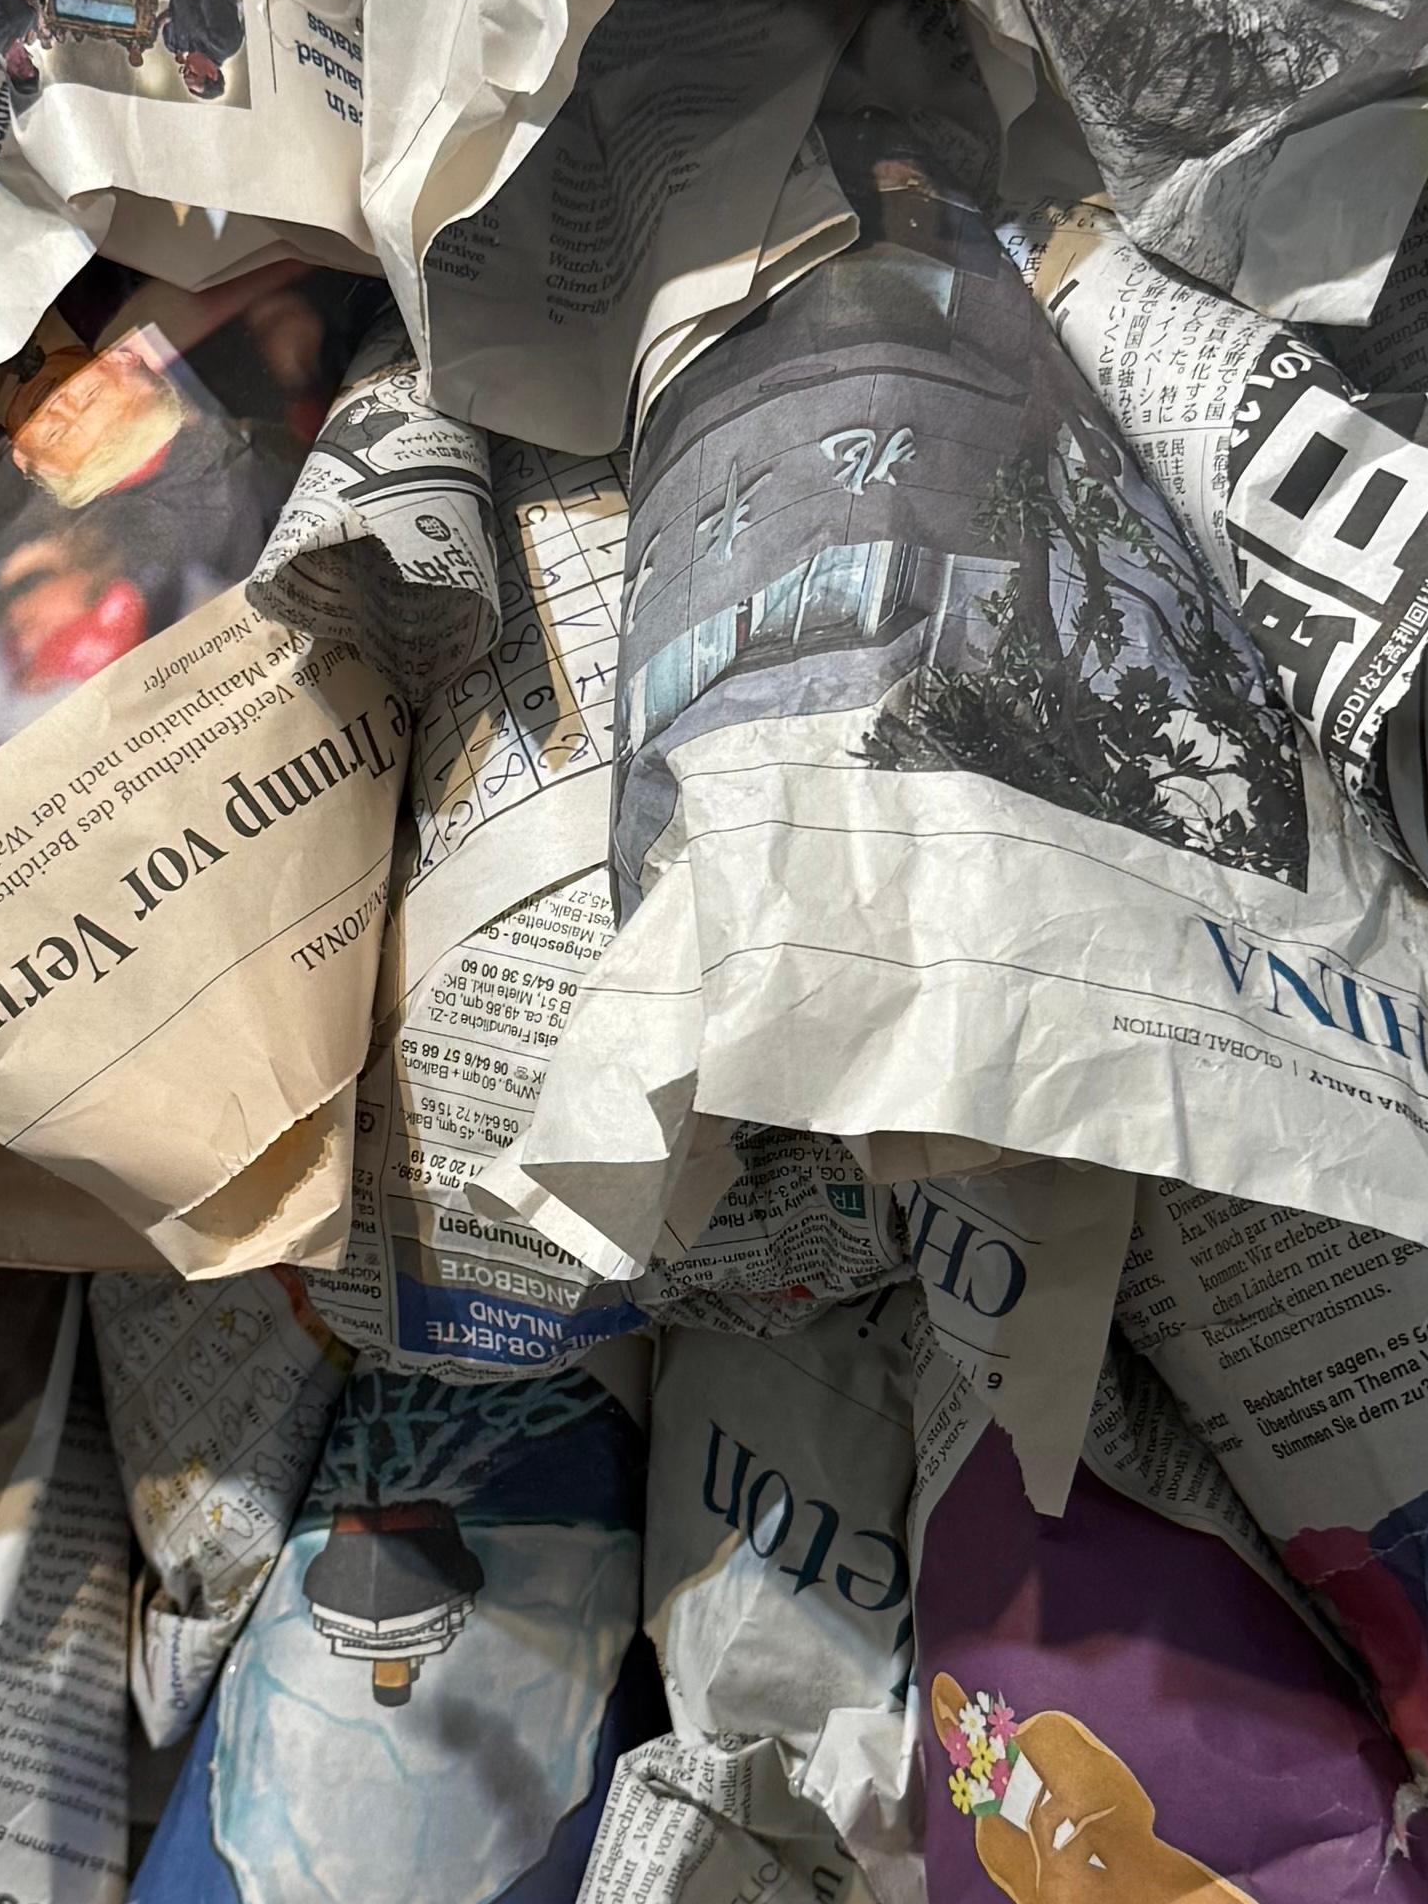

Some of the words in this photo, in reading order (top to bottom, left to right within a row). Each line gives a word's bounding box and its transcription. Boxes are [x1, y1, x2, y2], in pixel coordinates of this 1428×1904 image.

[143, 616, 253, 693] Niederndorfer
[123, 661, 268, 754] Manipulation
[66, 749, 125, 796] nach
[113, 684, 294, 803] Veröffentlichung
[224, 699, 398, 838] Trump
[30, 792, 68, 828] der
[75, 798, 116, 834] des
[120, 827, 228, 921] vor
[1111, 1014, 1203, 1046] EDITION
[407, 1148, 426, 1166] 19
[428, 1153, 449, 1171] 20
[447, 1158, 468, 1176] 20
[440, 1258, 582, 1310] ANGEBOTE
[468, 1300, 563, 1340] INLAND
[1248, 1282, 1393, 1355] Konservatismus.
[1241, 1369, 1325, 1416] Beobachter
[1325, 1346, 1387, 1380] sagen,
[1386, 1331, 1411, 1353] es
[1256, 1398, 1329, 1438] Überdruss
[1327, 1386, 1357, 1410] am
[1353, 1357, 1422, 1395] Thema
[1271, 1426, 1336, 1461] Stimmen
[1330, 1415, 1359, 1436] Sie
[1357, 1396, 1401, 1426] dem
